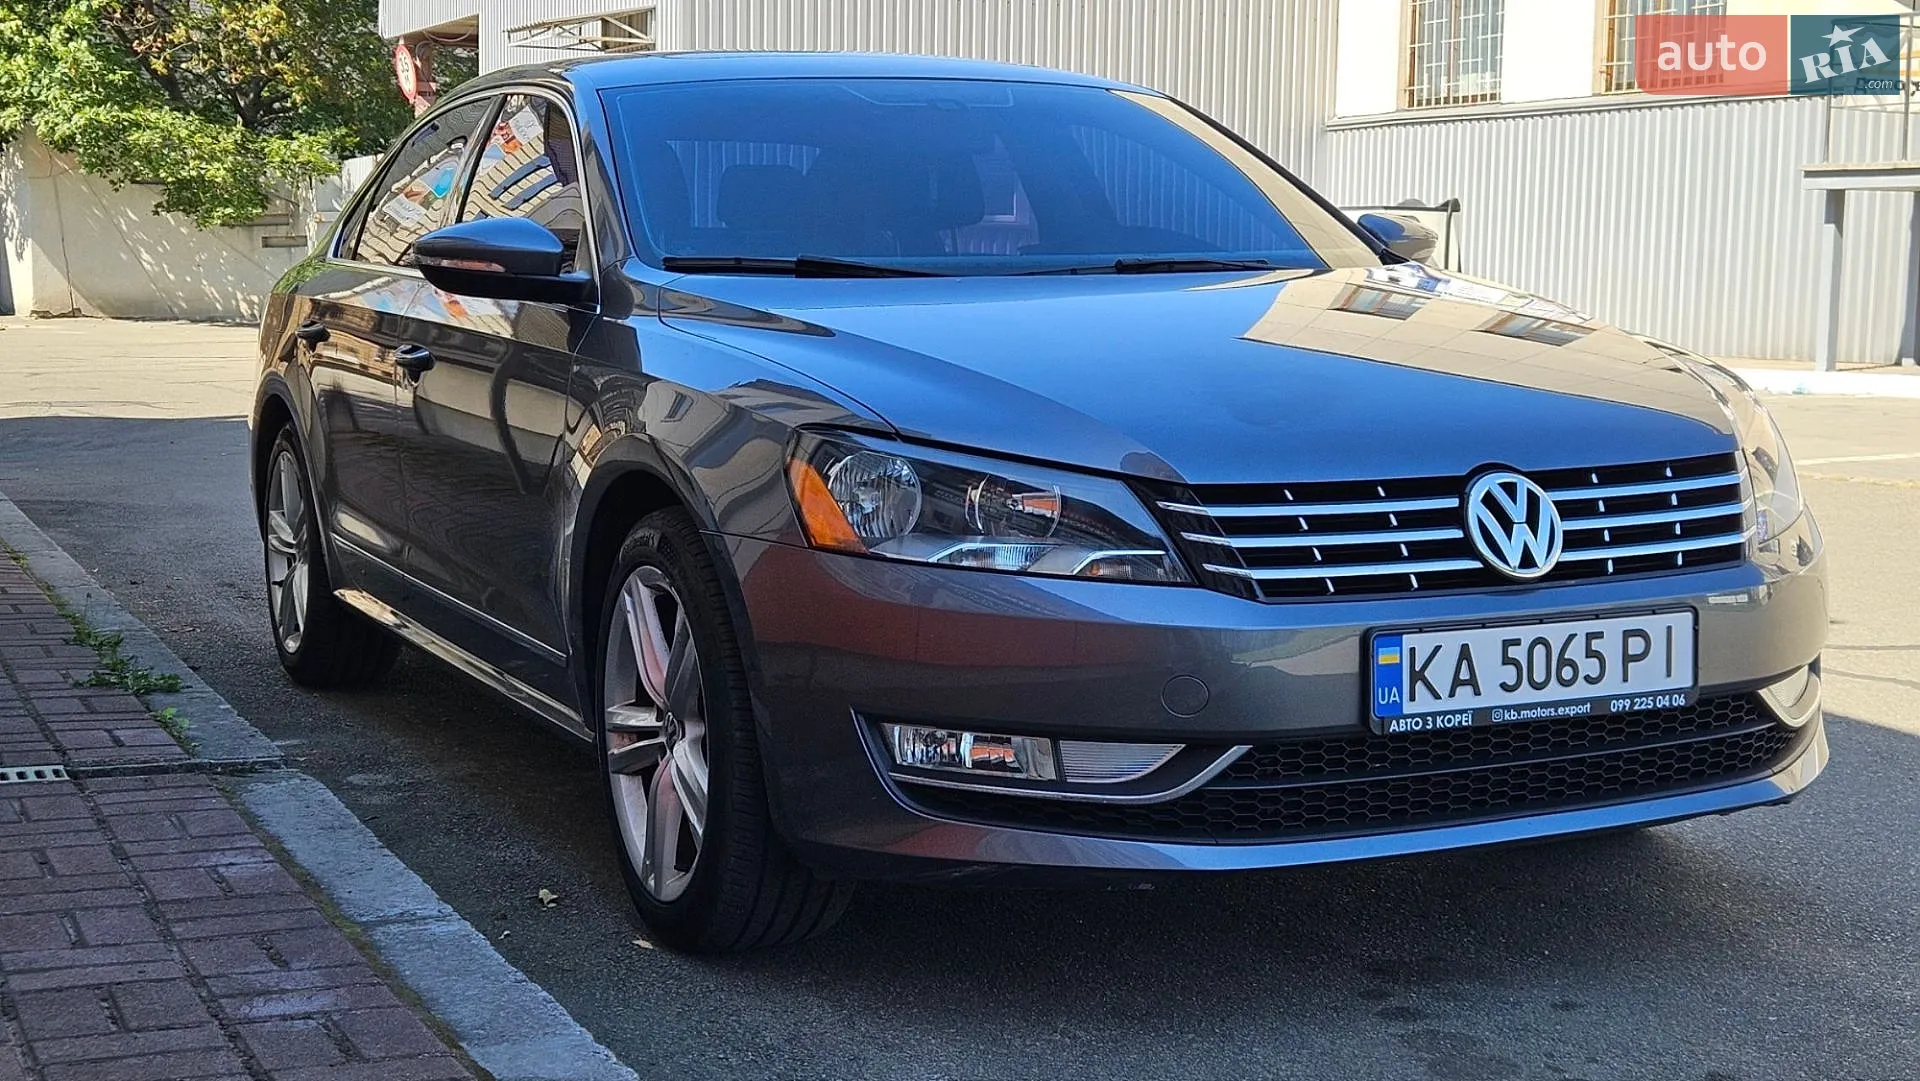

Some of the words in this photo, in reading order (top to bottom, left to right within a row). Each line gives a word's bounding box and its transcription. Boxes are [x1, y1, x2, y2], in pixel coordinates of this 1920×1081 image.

[1408, 643, 1482, 702] KA
[1499, 631, 1606, 692] 5065
[1378, 686, 1400, 705] UA
[1610, 699, 1631, 712] 099
[1633, 696, 1654, 710] 225
[1656, 694, 1670, 708] 04
[1672, 693, 1687, 706] 06
[1504, 702, 1592, 720] kb.motors.export
[1389, 717, 1423, 732] АВТО
[1436, 710, 1474, 729] КОРЕЇ
